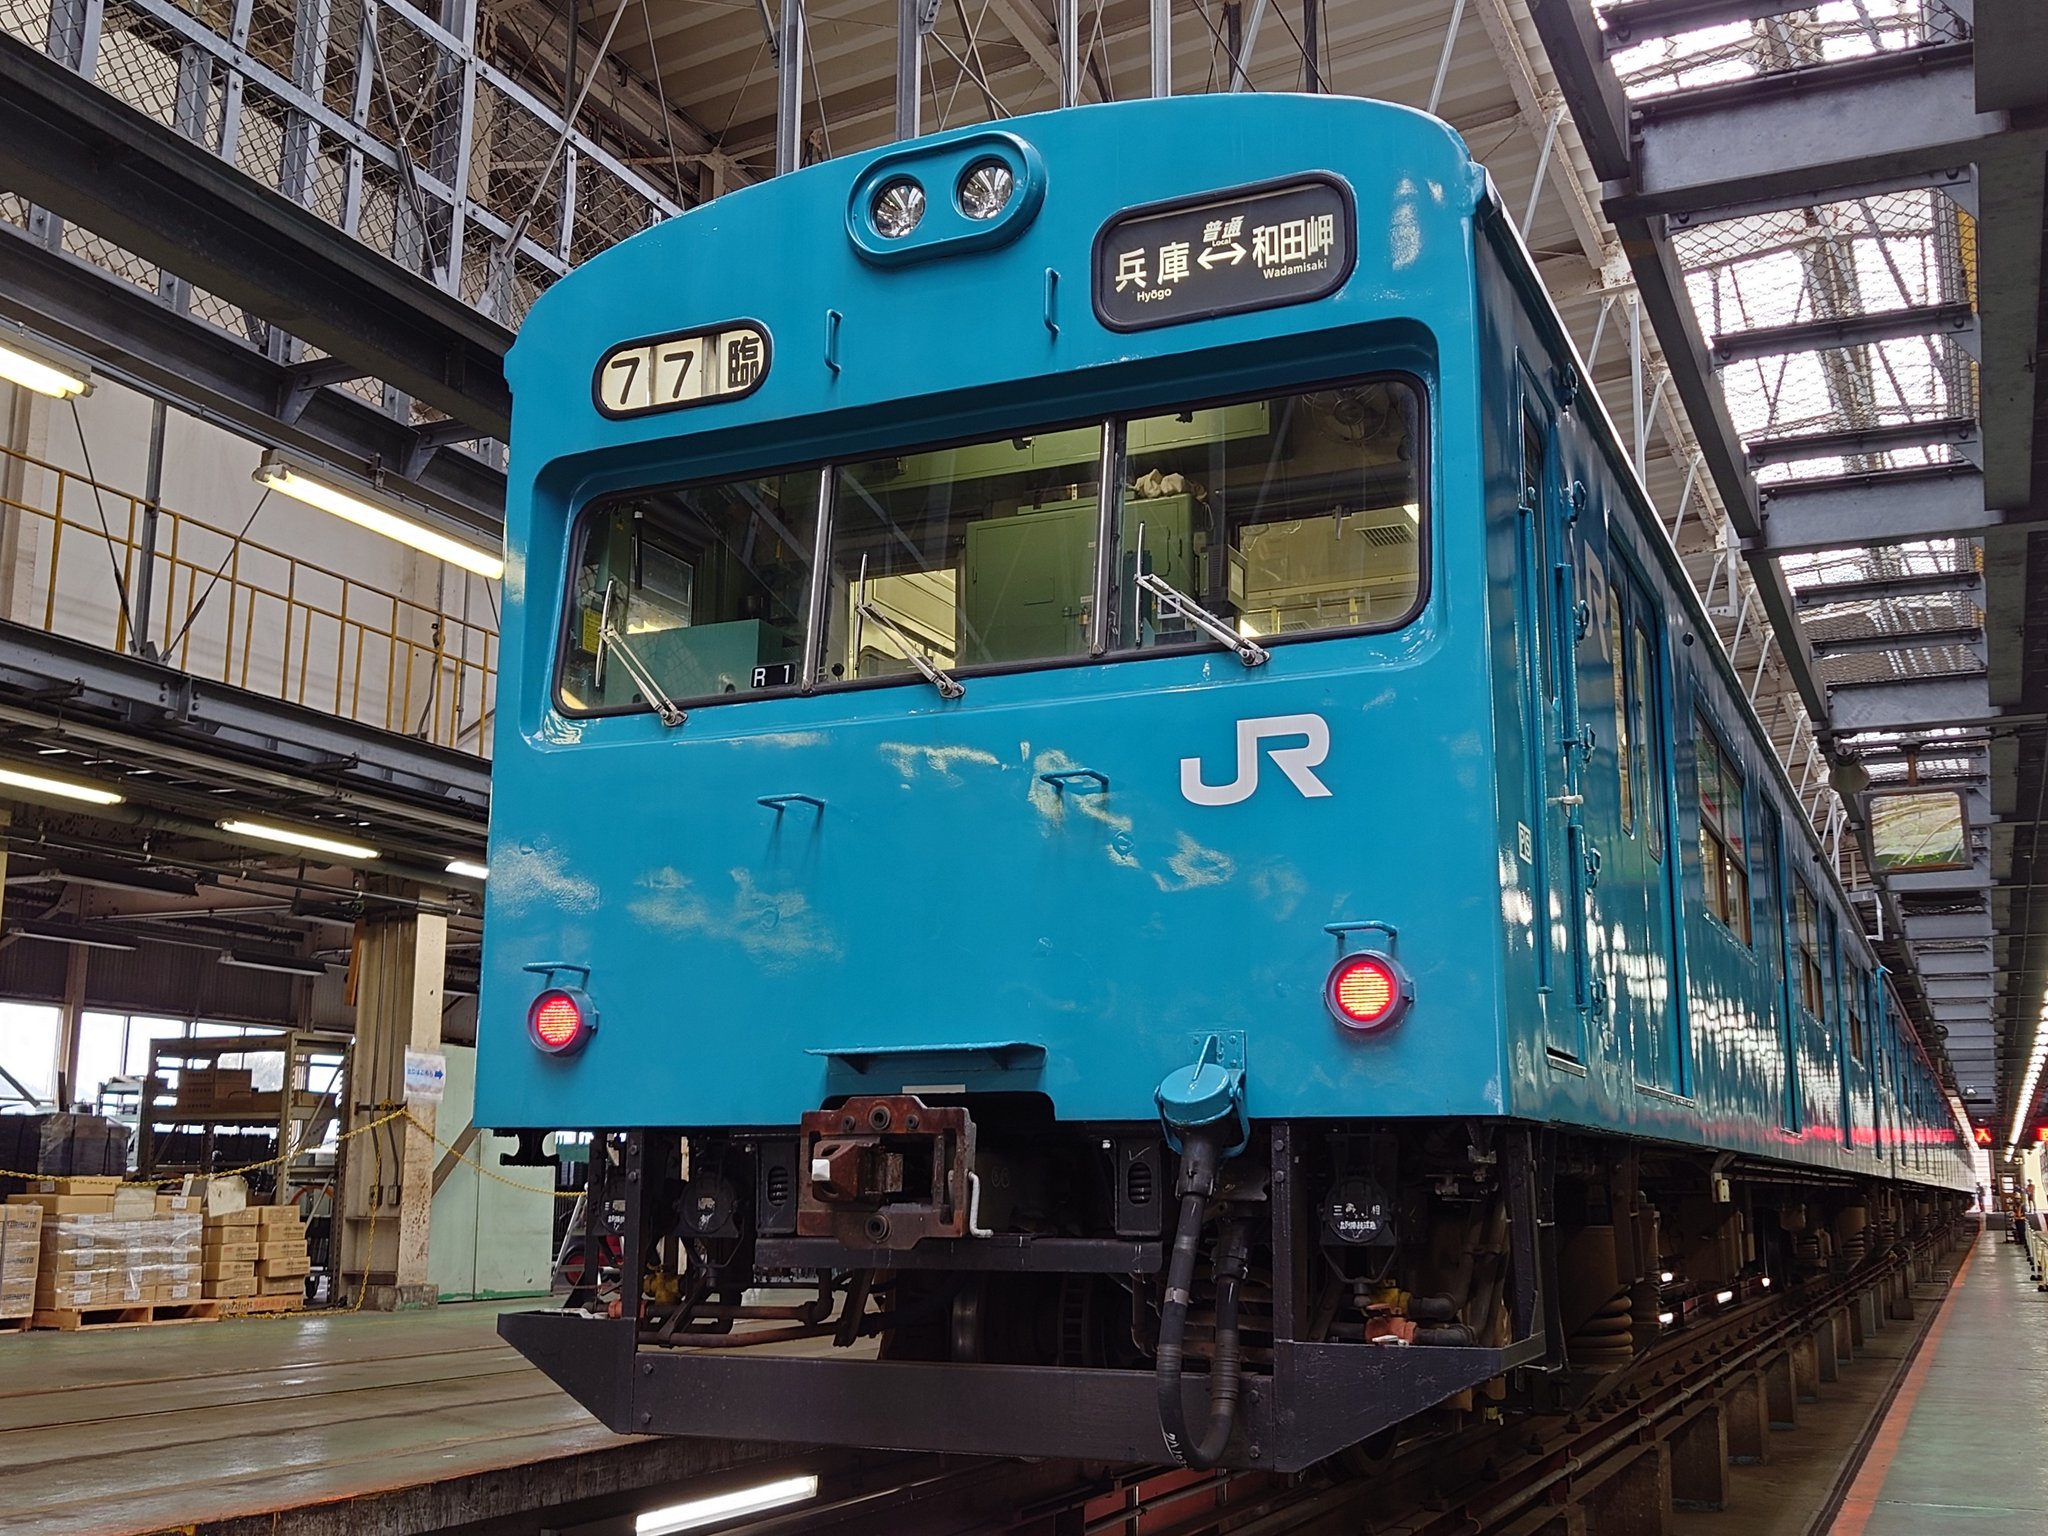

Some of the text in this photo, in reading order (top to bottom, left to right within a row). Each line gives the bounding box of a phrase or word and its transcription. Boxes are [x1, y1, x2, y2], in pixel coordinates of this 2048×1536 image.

[1202, 215, 1245, 243] 普通
[1115, 214, 1334, 292] 兵庫 和田岬
[1212, 237, 1232, 247] Local
[1263, 258, 1328, 279] Wadamisaki
[1136, 287, 1172, 303] Hyōgo
[728, 335, 760, 389] 臨
[753, 668, 766, 687] R
[1180, 713, 1333, 806] JR
